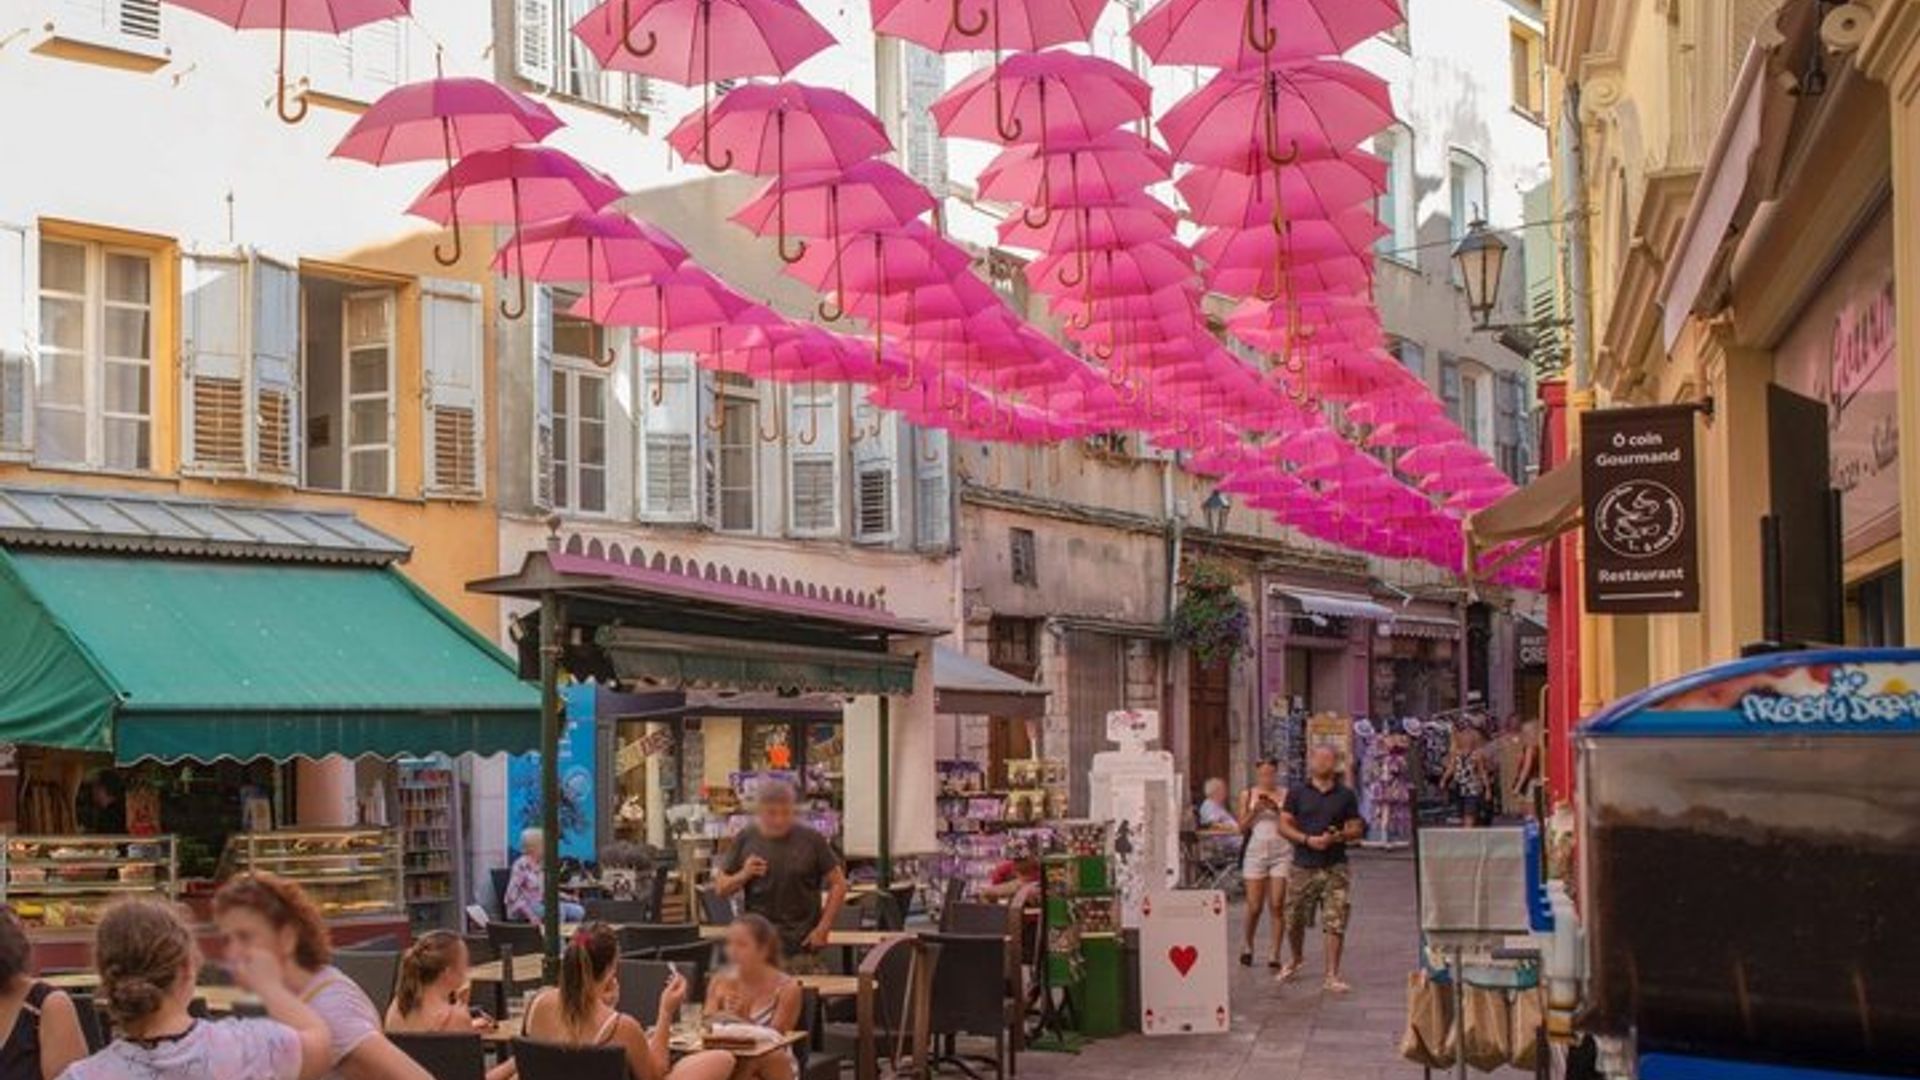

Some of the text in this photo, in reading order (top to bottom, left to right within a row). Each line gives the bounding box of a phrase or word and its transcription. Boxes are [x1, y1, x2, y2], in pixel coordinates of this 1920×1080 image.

[1629, 432, 1662, 446] coin
[1596, 449, 1680, 466] Gourmand
[1599, 569, 1684, 583] Restaurant
